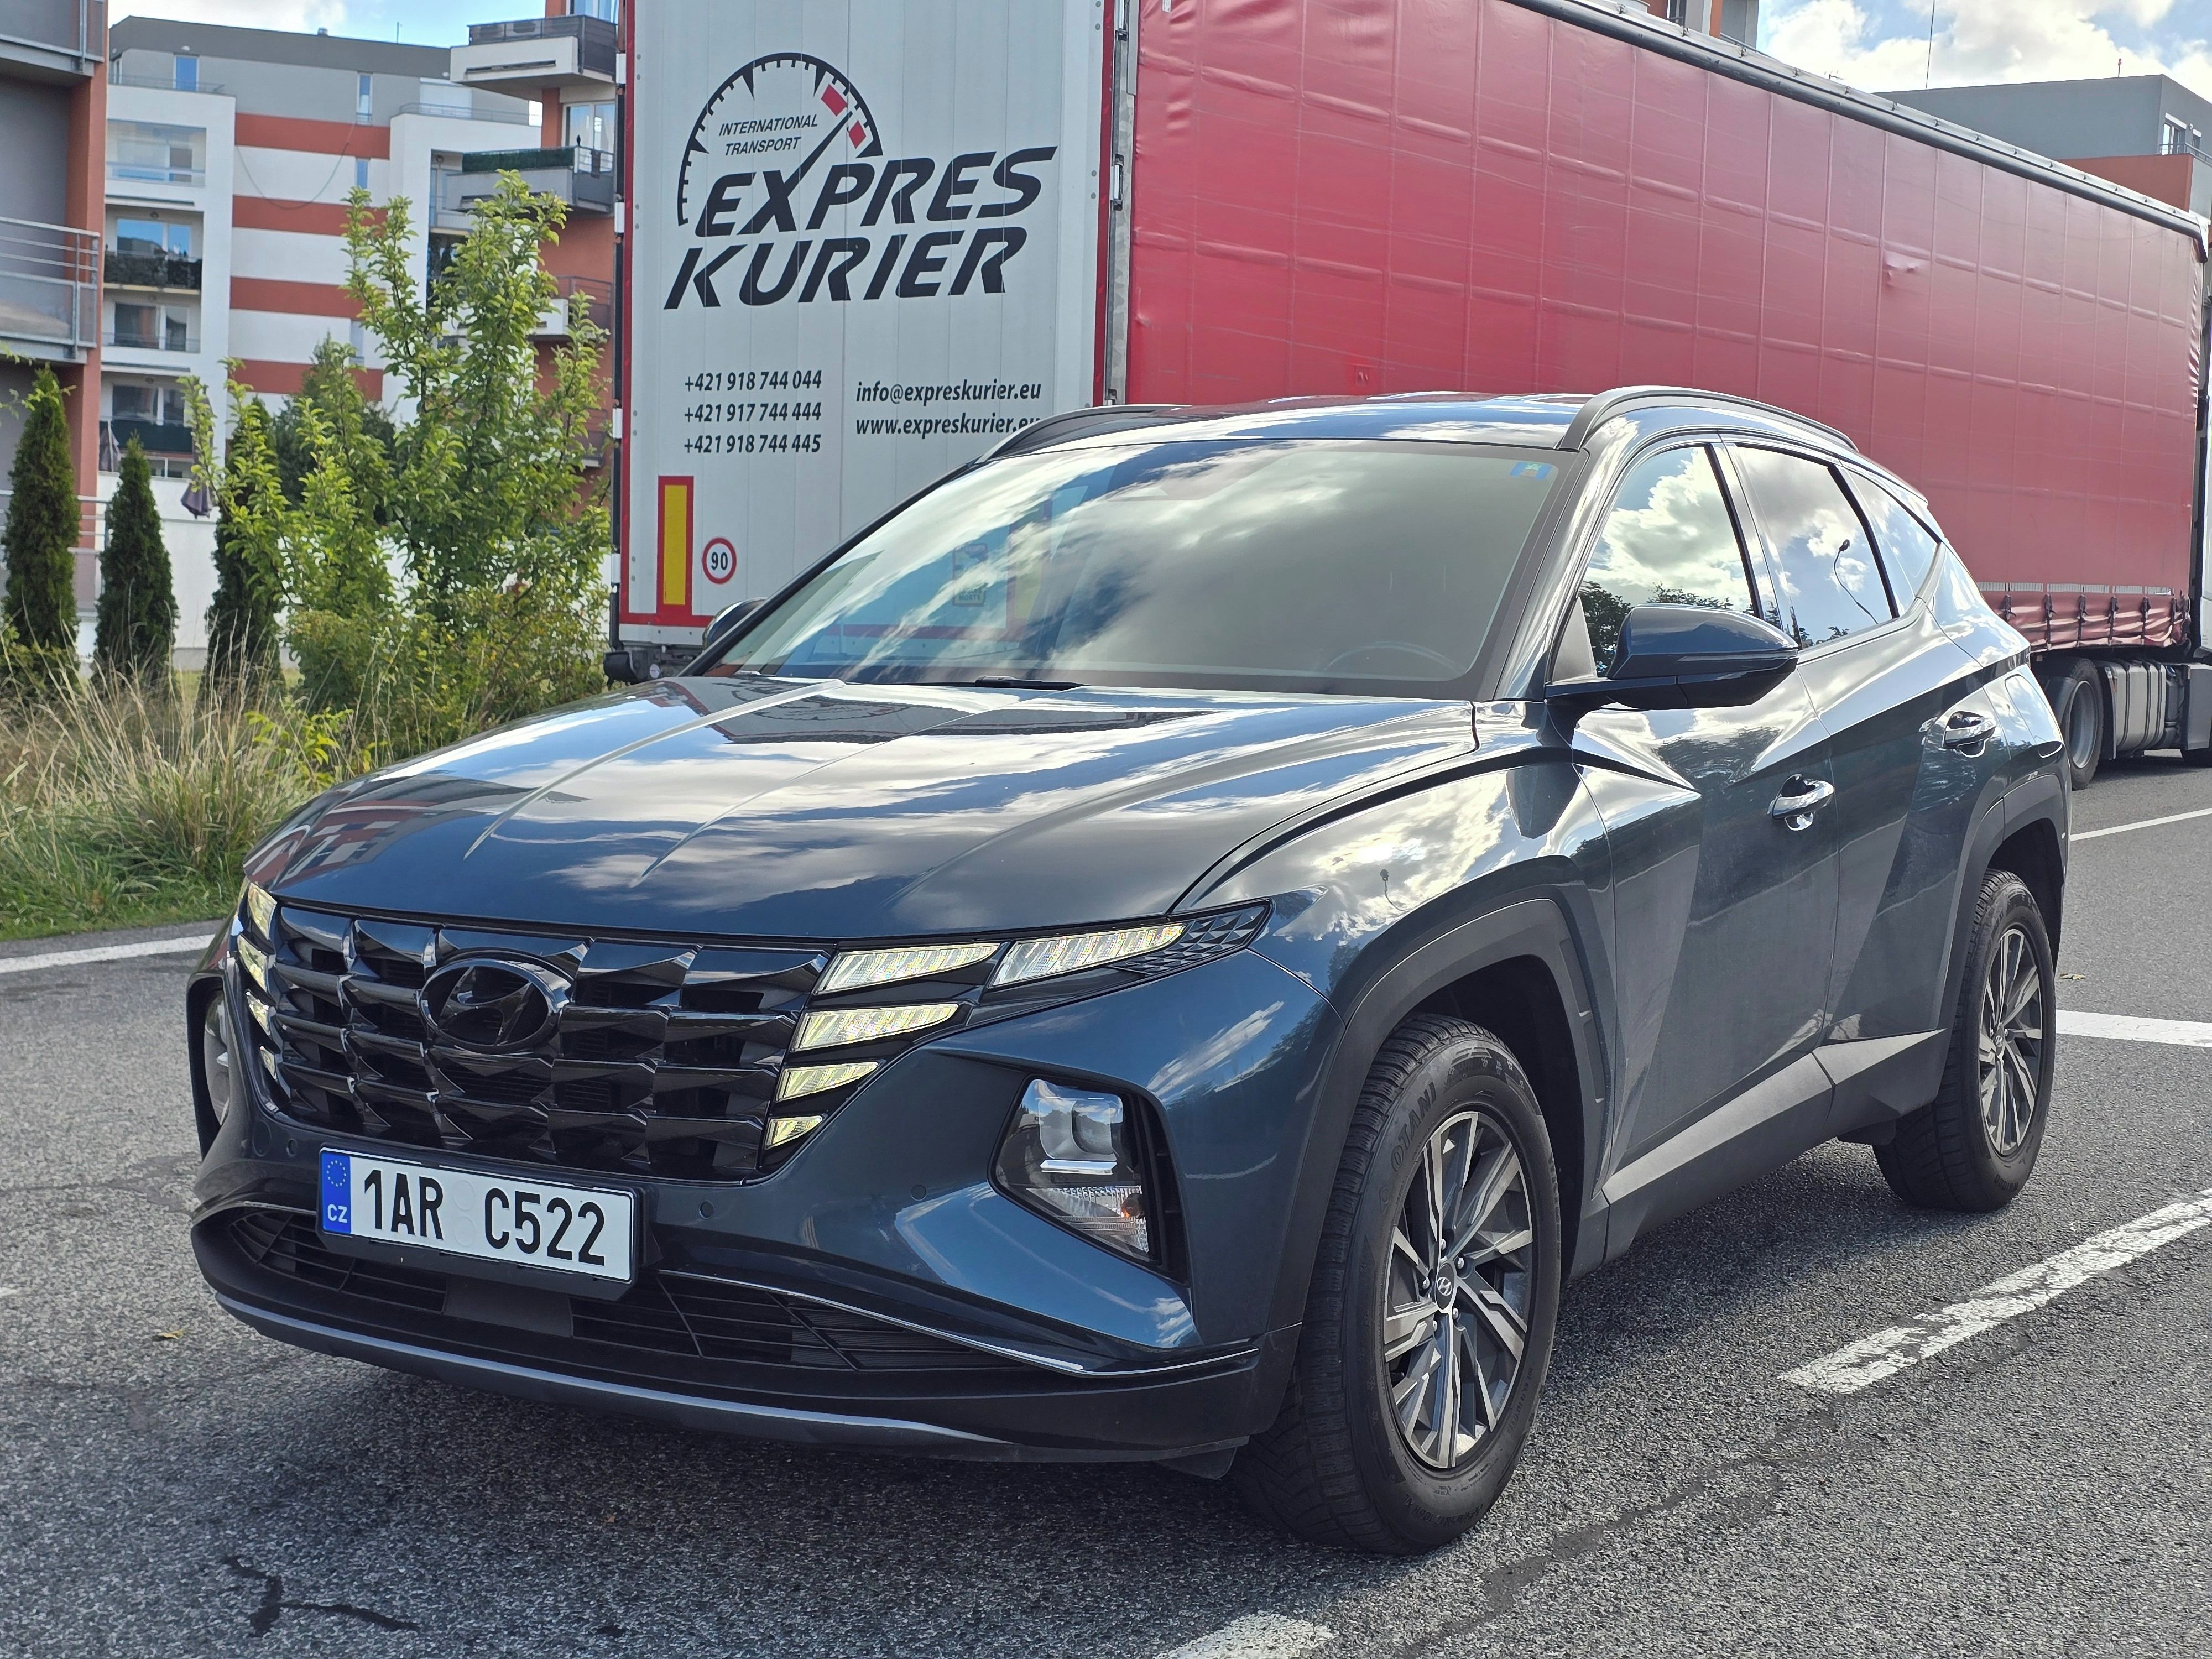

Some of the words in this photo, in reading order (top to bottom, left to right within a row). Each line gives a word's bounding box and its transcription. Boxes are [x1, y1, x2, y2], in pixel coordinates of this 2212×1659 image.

[719, 114, 818, 137] INTERNATIONAL
[725, 137, 802, 156] TRANSPORT
[695, 146, 1058, 237] EXPRES
[663, 226, 1027, 310] KURIER
[685, 373, 722, 392] +421
[727, 372, 756, 391] 918
[759, 371, 789, 390] 744
[792, 370, 822, 389] 044
[856, 378, 1041, 407] info@expreskurier.eu
[684, 404, 722, 422] +421
[727, 403, 756, 422] 917
[759, 403, 788, 421] 744
[791, 402, 822, 421] 444
[684, 435, 721, 453] +421
[727, 434, 755, 453] 918
[759, 434, 787, 453] 744
[791, 434, 821, 453] 445
[711, 551, 728, 571] 90
[327, 1203, 348, 1223] CZ
[364, 1169, 444, 1240] 1AR
[484, 1188, 606, 1266] C522
